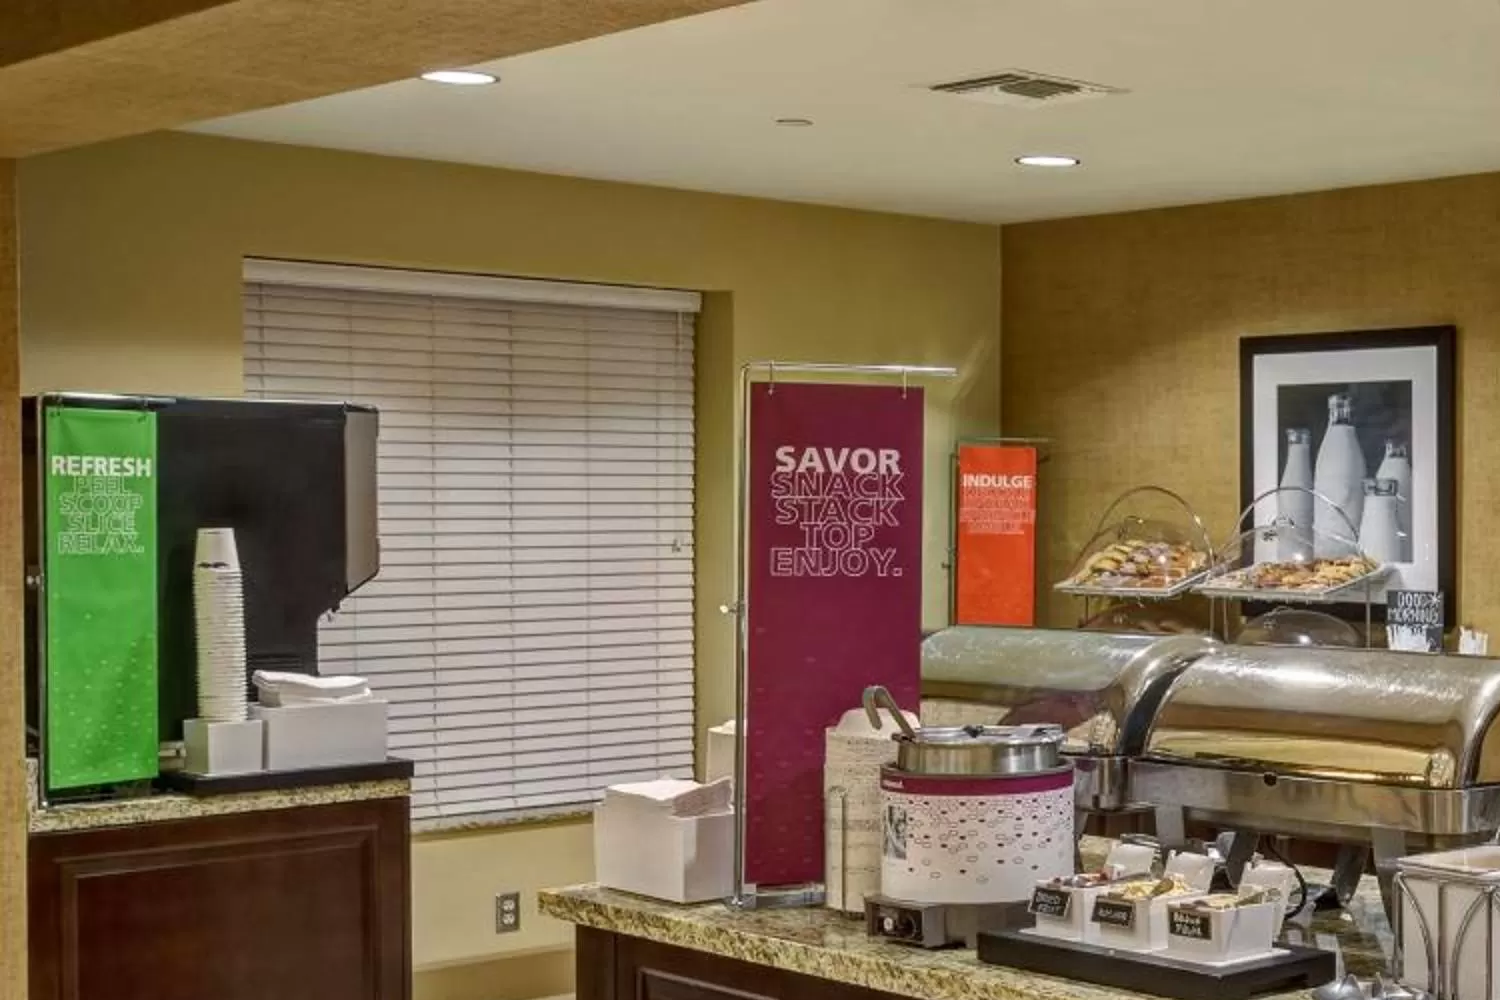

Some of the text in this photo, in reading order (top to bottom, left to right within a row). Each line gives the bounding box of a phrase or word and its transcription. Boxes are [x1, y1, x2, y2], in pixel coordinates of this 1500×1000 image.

[51, 455, 152, 477] REFRESH
[775, 445, 900, 474] SAVOR
[770, 471, 904, 500] SNACK
[963, 473, 1033, 489] INDULGE
[775, 498, 900, 526] STACK
[799, 522, 875, 550] TOP
[769, 547, 903, 577] ENJOY.
